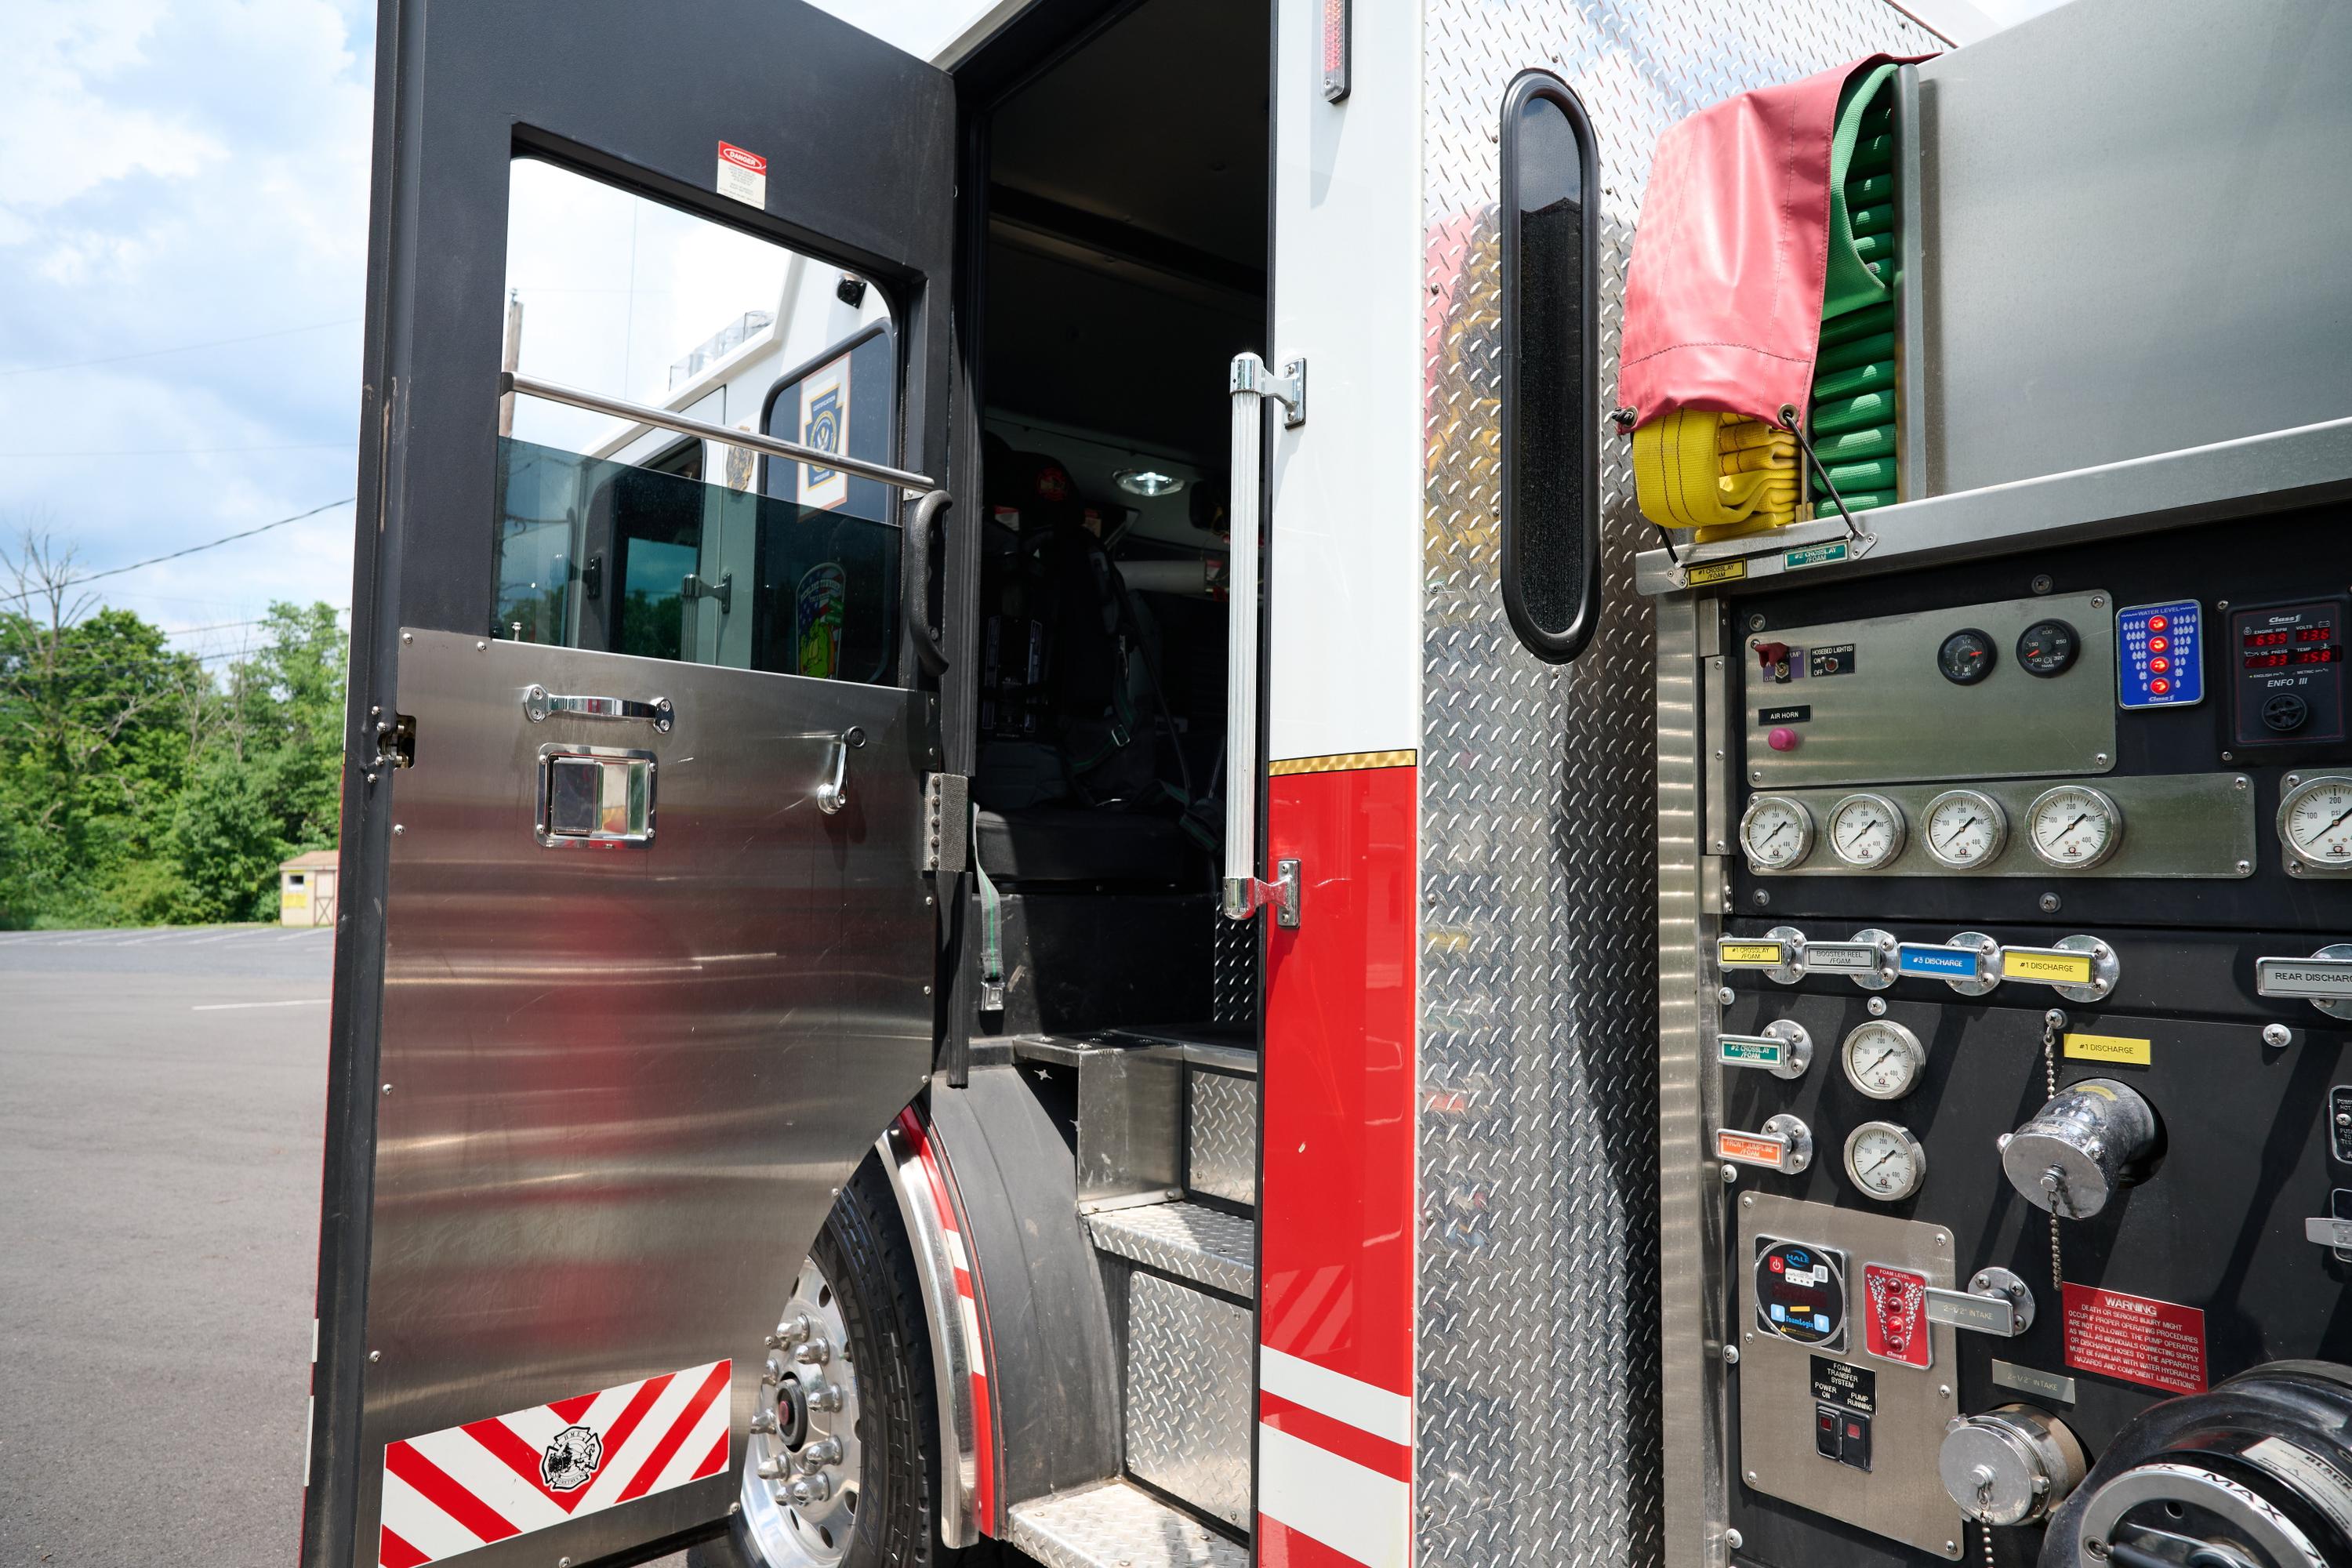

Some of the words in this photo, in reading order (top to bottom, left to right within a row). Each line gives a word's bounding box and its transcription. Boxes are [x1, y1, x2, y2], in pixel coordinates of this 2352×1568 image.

[729, 151, 757, 166] DANGER
[1805, 546, 1837, 557] CROSSLAY
[1806, 554, 1828, 564] /FOAM
[1706, 564, 1734, 574] CROSSLAY
[2256, 633, 2287, 646] 699
[2269, 654, 2287, 666] 33
[2267, 678, 2294, 688] ENFO
[1925, 957, 1963, 967] DISCHARGE
[2031, 963, 2074, 972] DISCHARGE
[2275, 972, 2302, 981] REAR
[1740, 1045, 1770, 1054] CROSSLAY
[2091, 1044, 2134, 1054] DISCHARGE
[1726, 1139, 1744, 1148] FRONT
[1747, 1142, 1773, 1152] JUMPLINE
[1740, 1149, 1760, 1157] /FOAM
[1787, 1254, 1810, 1264] HALE
[2105, 1296, 2157, 1315] WARNING
[1969, 1310, 1994, 1319] INTAKE
[2082, 1304, 2101, 1314] DEATH
[2113, 1310, 2138, 1322] SERIOUS
[2140, 1317, 2161, 1327] INJURY
[2163, 1321, 2183, 1331] MIGHT
[1786, 1315, 1814, 1329] FoamLogix
[2068, 1311, 2089, 1319] OCCUR
[2096, 1316, 2120, 1327] PROPER
[2122, 1322, 2155, 1334] OPERATING
[2156, 1330, 2198, 1344] PROCEDURES
[2078, 1330, 2093, 1339] WELL
[2104, 1336, 2138, 1348] INDIVIDUALS
[2140, 1344, 2175, 1357] CONNECTING
[2176, 1352, 2198, 1363] SUPPLY
[2131, 1333, 2143, 1341] THE
[2145, 1336, 2162, 1345] PUMP
[2165, 1340, 2198, 1353] OPERATOR
[2080, 1338, 2113, 1352] DISCHARGE
[2114, 1348, 2134, 1357] HOSES
[2161, 1358, 2199, 1372] APPARATUS
[1834, 1363, 1851, 1373] FOAM
[2070, 1345, 2085, 1354] MUST
[2095, 1352, 2122, 1363] FAMILIAR
[2122, 1358, 2138, 1367] WITH
[2140, 1363, 2160, 1371] WATER
[2161, 1367, 2201, 1381] HYDRAULICS
[2074, 1355, 2102, 1367] HAZARDS
[2118, 1366, 2154, 1380] COMPONENT
[1827, 1368, 1858, 1382] TRANSFER
[1815, 1382, 1837, 1393] POWER
[1831, 1377, 1854, 1388] SYSTEM
[2034, 1380, 2057, 1391] INTAKE
[1851, 1392, 1868, 1402] PUMP
[1847, 1399, 1873, 1411] RUNNING
[2202, 1471, 2284, 1522] MAX
